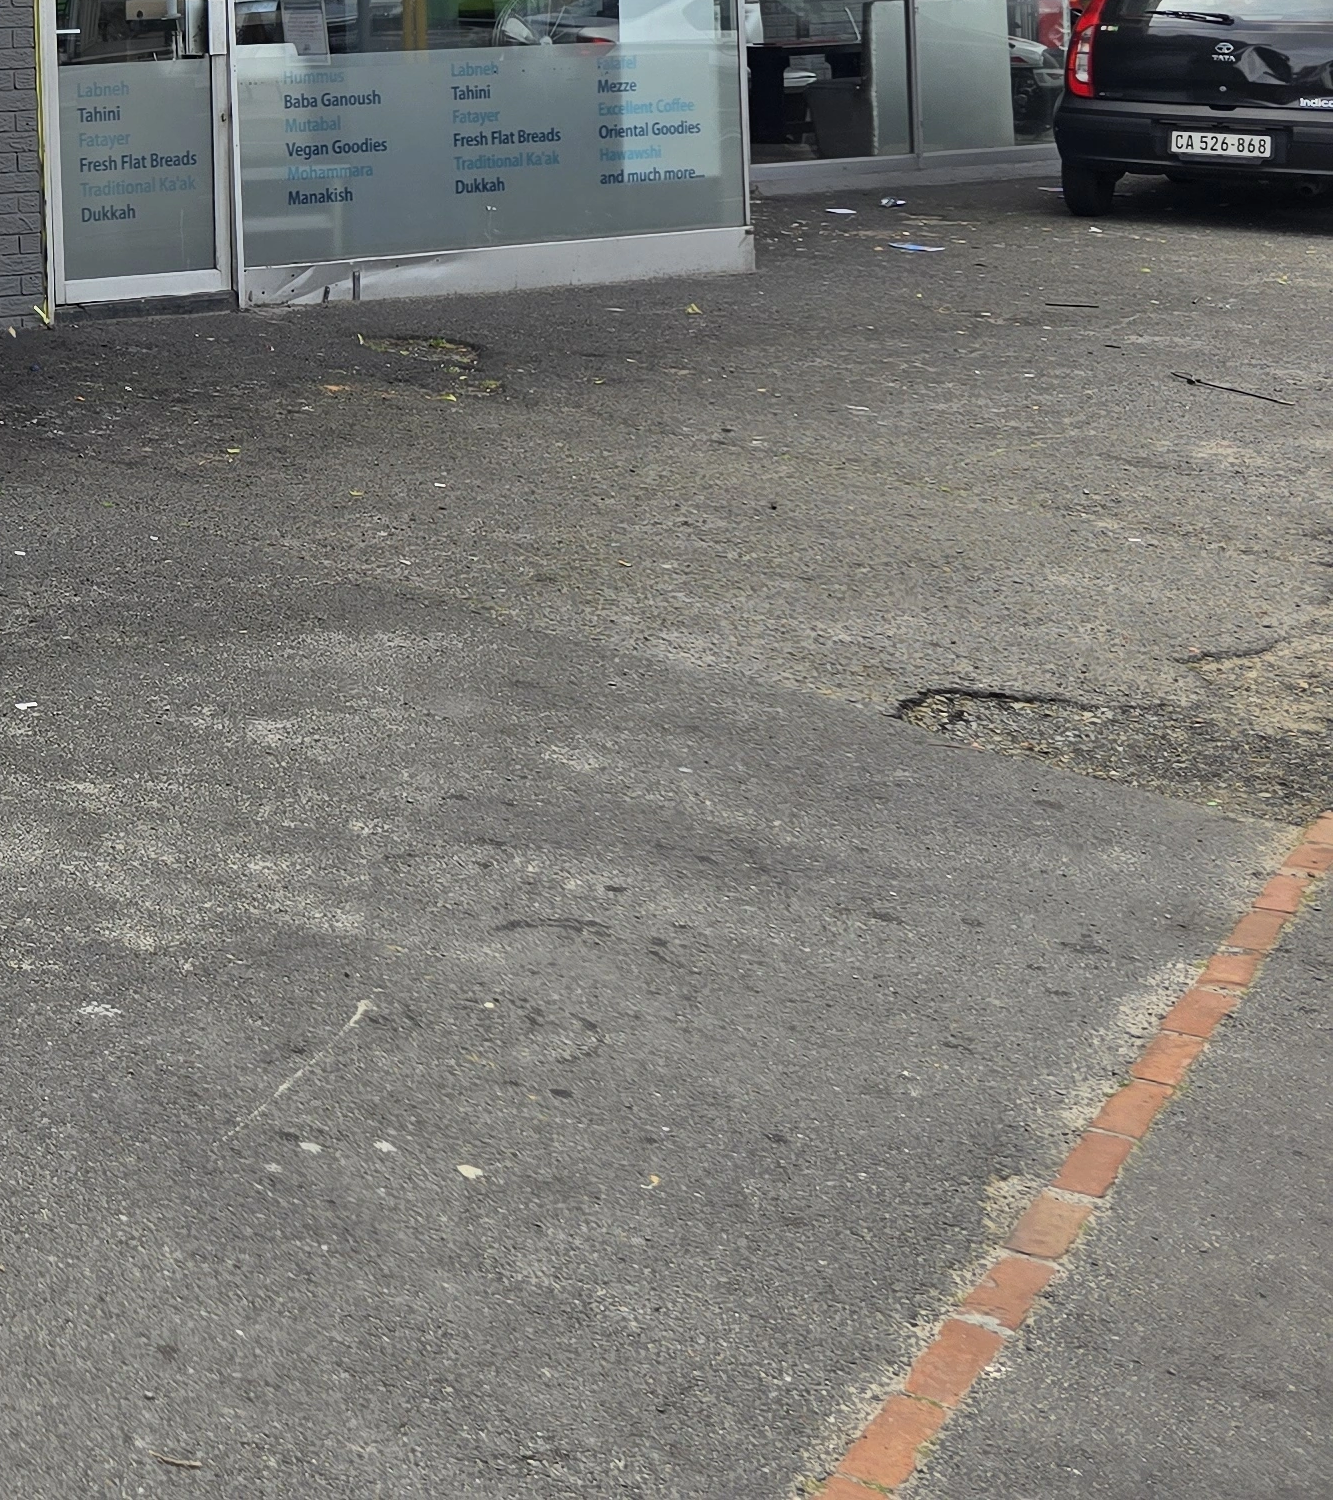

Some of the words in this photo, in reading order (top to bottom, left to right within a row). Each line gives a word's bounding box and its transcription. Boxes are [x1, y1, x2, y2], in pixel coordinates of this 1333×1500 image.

[1211, 54, 1237, 63] TATA
[283, 70, 346, 85] Hummus
[450, 62, 499, 77] Labneh
[76, 80, 130, 98] Labneh
[450, 84, 491, 101] Tahini
[597, 79, 638, 94] Mezze
[283, 92, 318, 109] Baba
[320, 89, 382, 108] Ganoush
[598, 100, 654, 117] Excellent
[655, 97, 696, 114] Coffee
[76, 105, 121, 123] Tahini
[452, 109, 501, 127] Fatayer
[284, 115, 342, 134] Mutabal
[598, 122, 649, 140] Oriental
[651, 119, 702, 137] Goodies
[78, 132, 132, 151] Fatayer
[453, 130, 489, 148] Fresh
[491, 129, 516, 145] Flat
[517, 127, 562, 144] Breads
[1175, 134, 1195, 151] CA
[1198, 135, 1268, 155] 526-868
[285, 141, 329, 161] Vegan
[331, 137, 388, 155] Goodies
[79, 155, 118, 173] Fresh
[120, 153, 148, 170] Flat
[149, 149, 198, 169] Breads
[454, 151, 524, 172] Traditional
[286, 163, 374, 181] Mohammara
[599, 168, 625, 185] and
[627, 166, 662, 183] much
[78, 176, 156, 198] Traditional
[454, 176, 506, 195] Dukkah
[287, 186, 354, 206] Manakish
[81, 203, 137, 223] Dukkah
